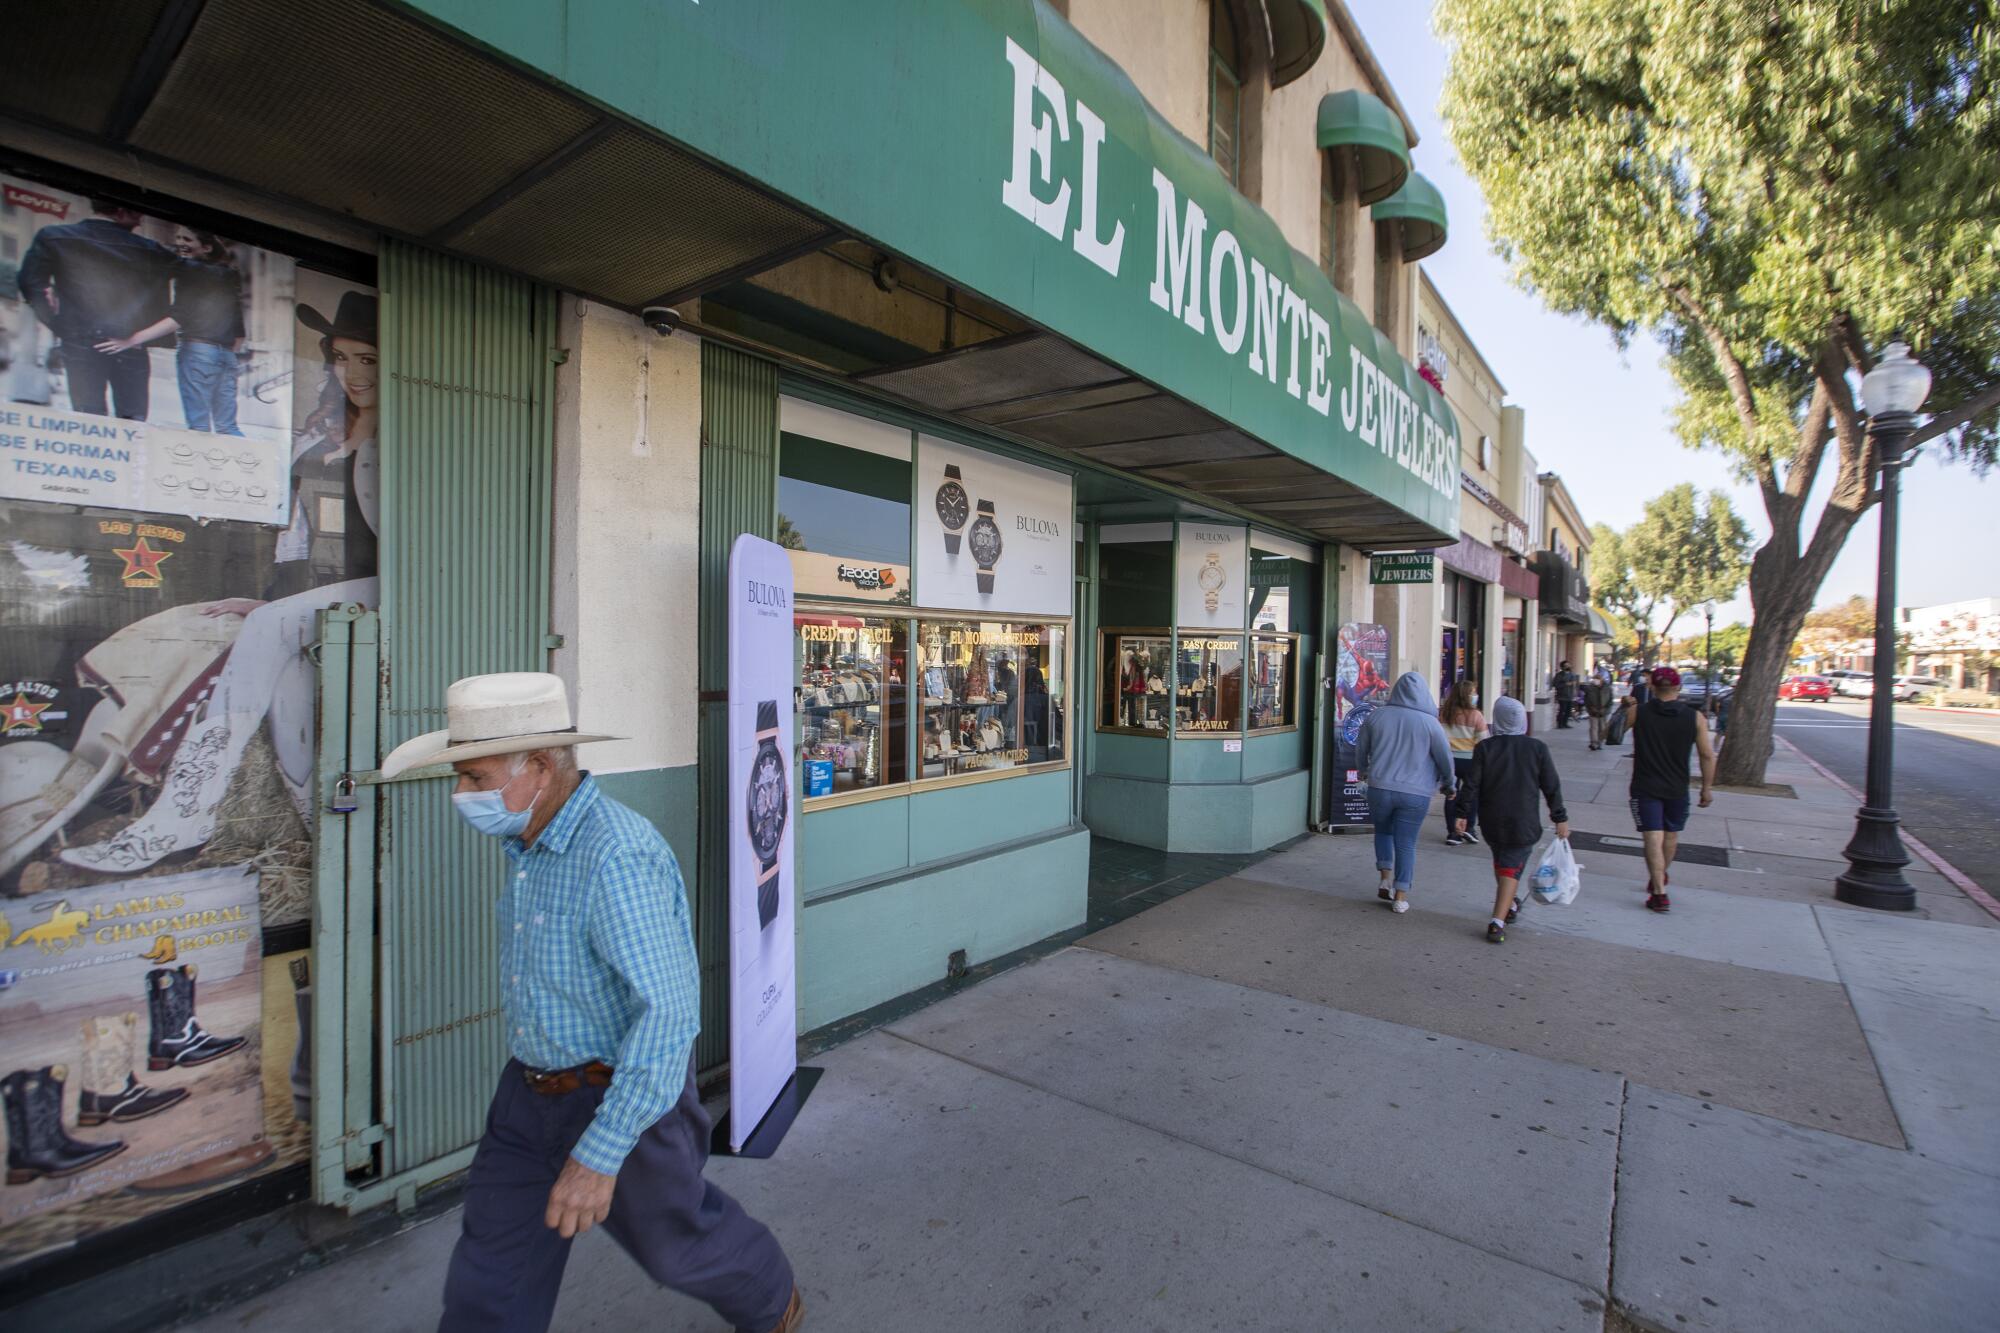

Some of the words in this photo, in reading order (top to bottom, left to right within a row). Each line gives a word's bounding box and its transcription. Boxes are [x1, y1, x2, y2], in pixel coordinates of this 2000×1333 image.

[1003, 36, 1125, 277] EL
[1150, 167, 1332, 416] MONTE
[1340, 344, 1456, 500] JEWELERS
[28, 415, 117, 439] LIMPIAN
[0, 434, 27, 449] SE
[34, 438, 130, 462] HORMAN
[12, 459, 117, 483] TEXANAS
[99, 521, 132, 535] LOS
[1016, 515, 1059, 537] BULOVA
[1195, 532, 1231, 542] BULOVA
[1383, 555, 1395, 565] EL
[1397, 554, 1433, 565] MONTE
[1381, 568, 1433, 581] JEWELERS
[748, 580, 786, 608] BULOVA
[801, 624, 857, 643] CREDITO
[950, 630, 963, 645] EL
[1183, 640, 1206, 650] EASY
[1207, 640, 1238, 650] CREDIT
[16, 681, 60, 699] ALTOS
[1190, 720, 1229, 730] LAYAWAY
[965, 753, 993, 769] PAGOS
[997, 748, 1029, 763] FACILES
[94, 891, 185, 921] LAMAS
[95, 905, 249, 945] CHAPARRAL
[178, 928, 249, 952] BOOTS
[20, 957, 91, 978] Chaparral
[95, 951, 134, 964] Boots
